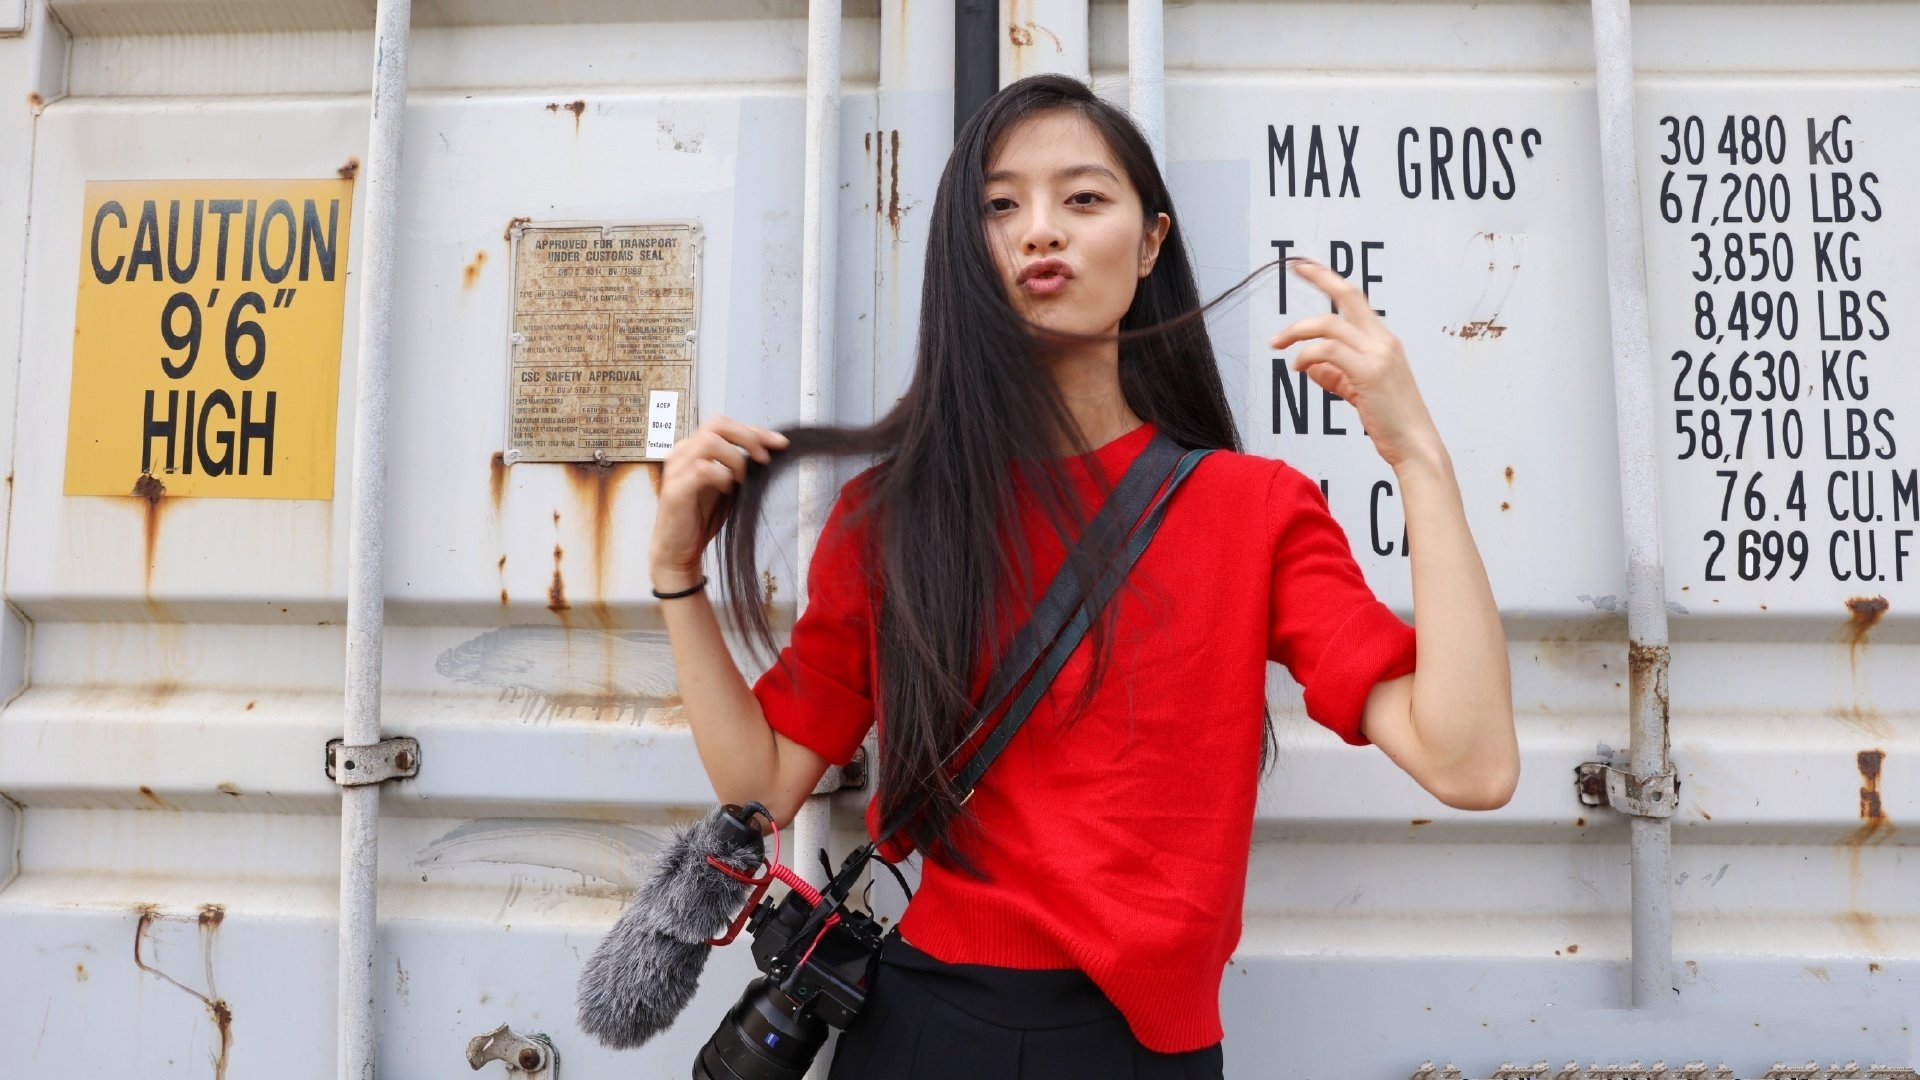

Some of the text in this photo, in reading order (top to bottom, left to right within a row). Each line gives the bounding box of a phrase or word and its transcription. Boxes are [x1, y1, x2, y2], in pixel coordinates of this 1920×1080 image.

[1268, 125, 1360, 197] MAX
[1660, 171, 1882, 226] 67,200 LBS
[91, 200, 339, 284] CAUTION
[535, 237, 678, 250] APPROVED FOR TRANSPORT
[548, 249, 664, 262] UNDER CUSTOMS SEAL
[1691, 232, 1862, 284] 3,850 KG
[1695, 290, 1890, 344] 8,490 LBS
[521, 371, 642, 382] CSC SAFETY APPROVAL
[1272, 359, 1369, 435] NE
[1672, 350, 1869, 404] 26,630 KG
[142, 389, 276, 477] HIGH
[1676, 408, 1897, 463] 58,710 LBS
[1370, 480, 1410, 557] C
[1717, 471, 1806, 521] 76.4
